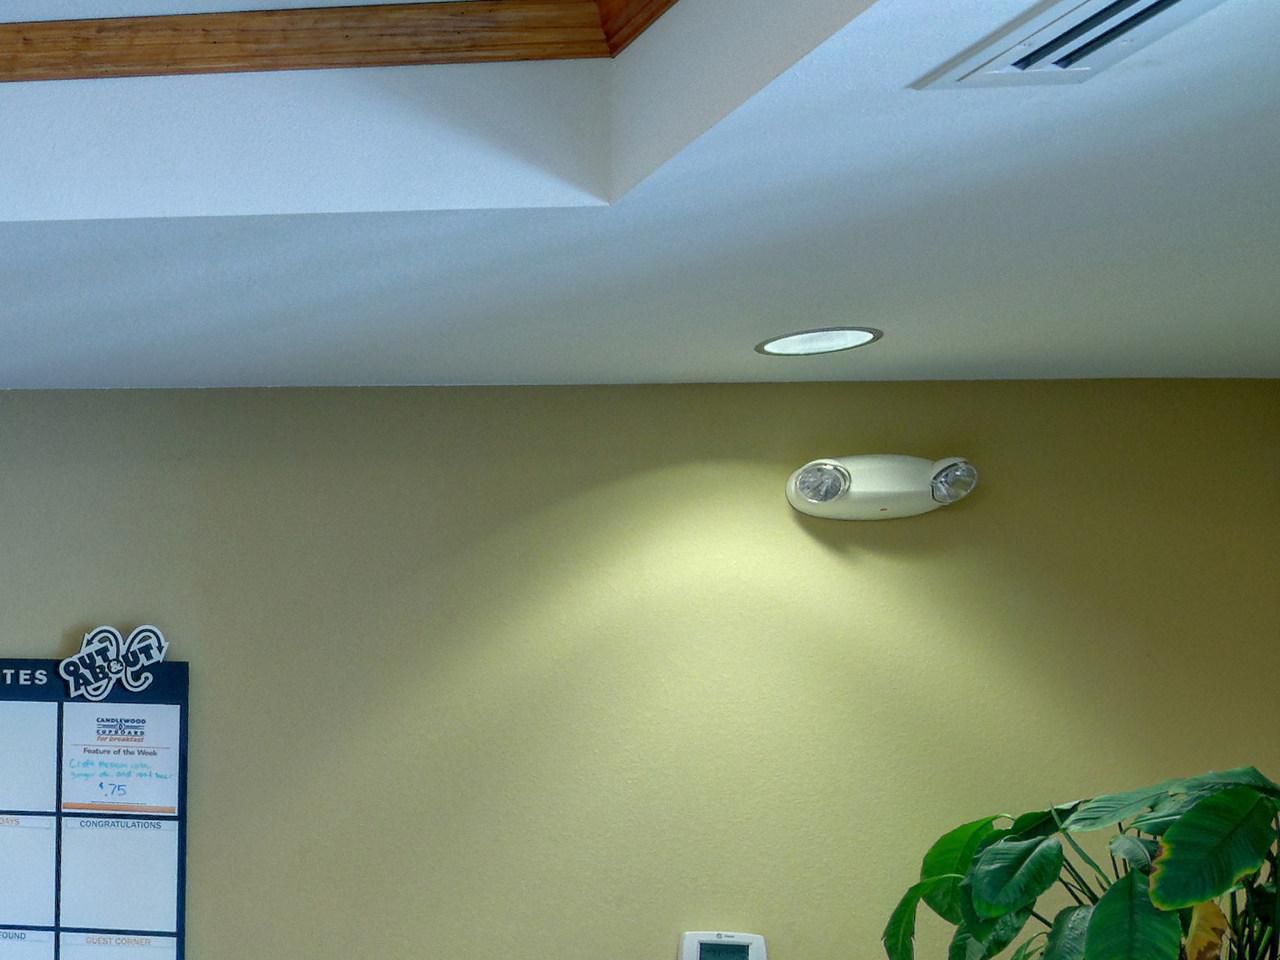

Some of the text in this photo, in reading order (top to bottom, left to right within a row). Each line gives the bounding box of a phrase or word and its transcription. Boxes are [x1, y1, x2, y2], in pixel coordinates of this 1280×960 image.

[137, 749, 158, 757] Week
[79, 819, 162, 830] CONGRATULATIONS
[86, 936, 151, 946] GUEST CORNER
